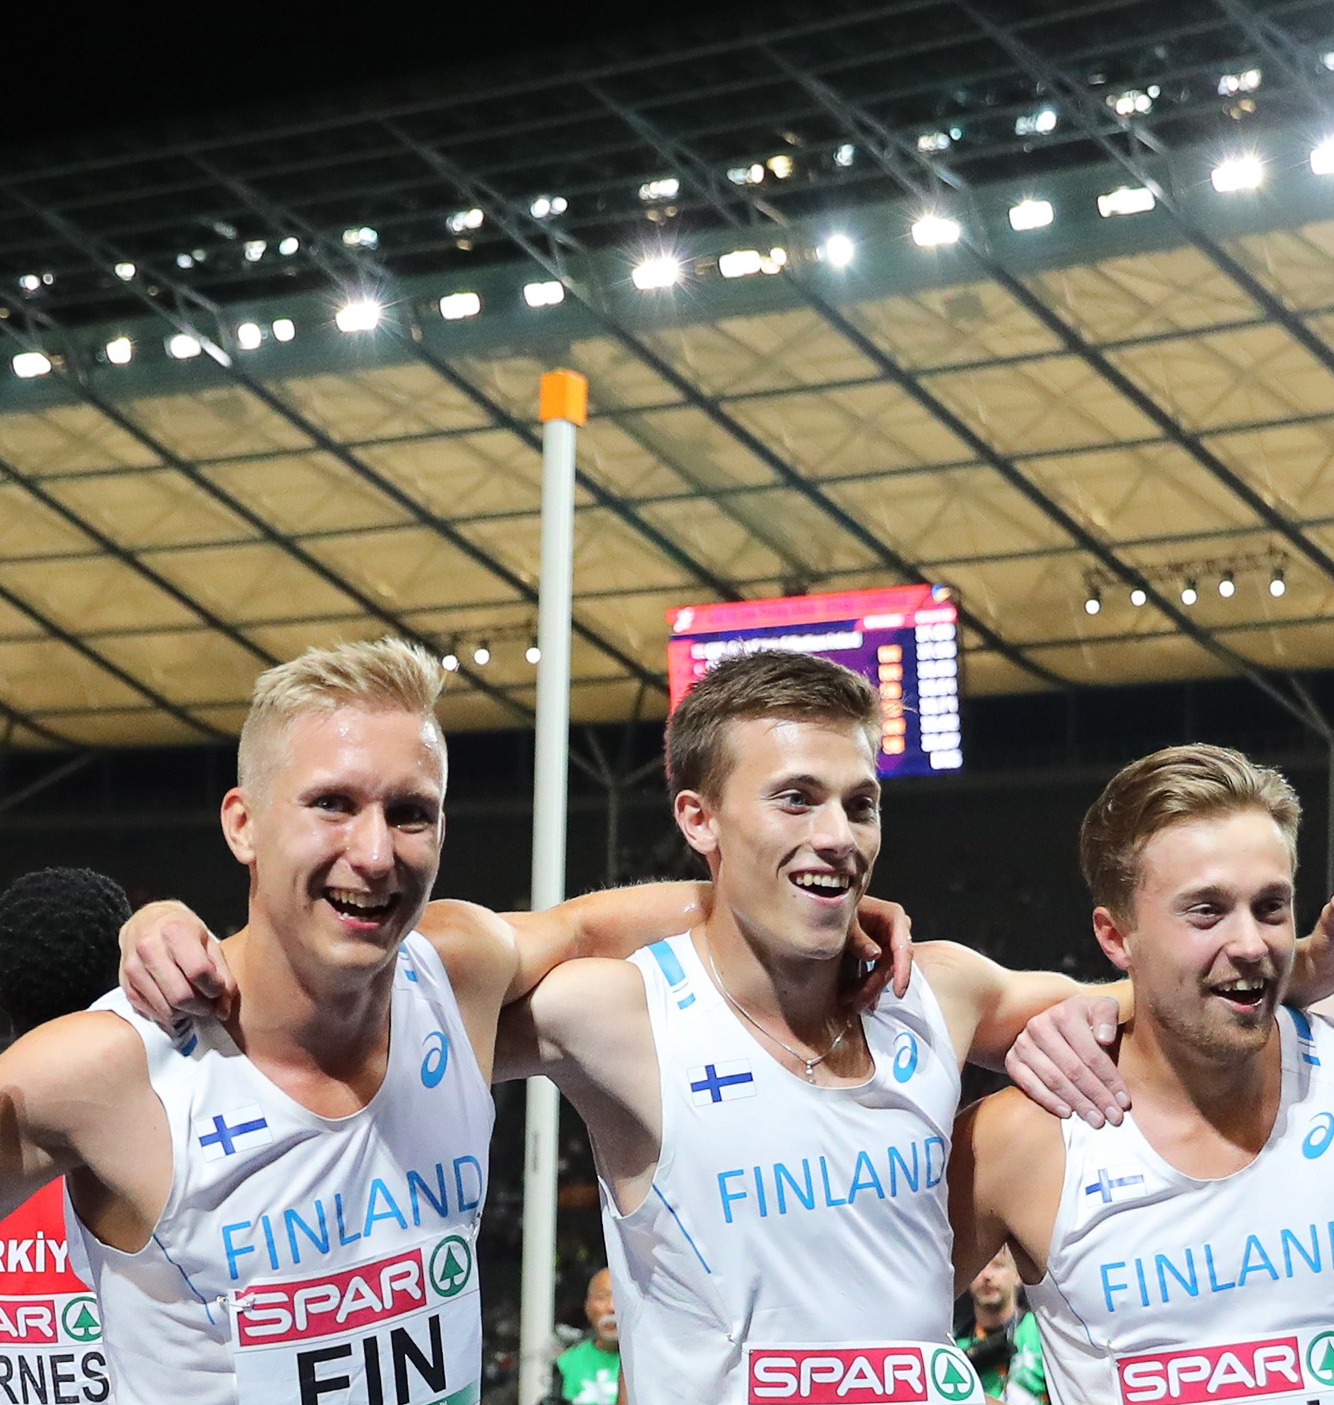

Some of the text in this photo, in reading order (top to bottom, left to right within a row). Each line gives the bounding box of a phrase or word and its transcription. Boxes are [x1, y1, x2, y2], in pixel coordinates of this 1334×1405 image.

[222, 1155, 483, 1280] FINLAND
[717, 1136, 946, 1224] FINLAND
[242, 1258, 422, 1338] SPAR
[752, 1354, 924, 1397] SPAR
[1122, 1343, 1300, 1402] SPAR
